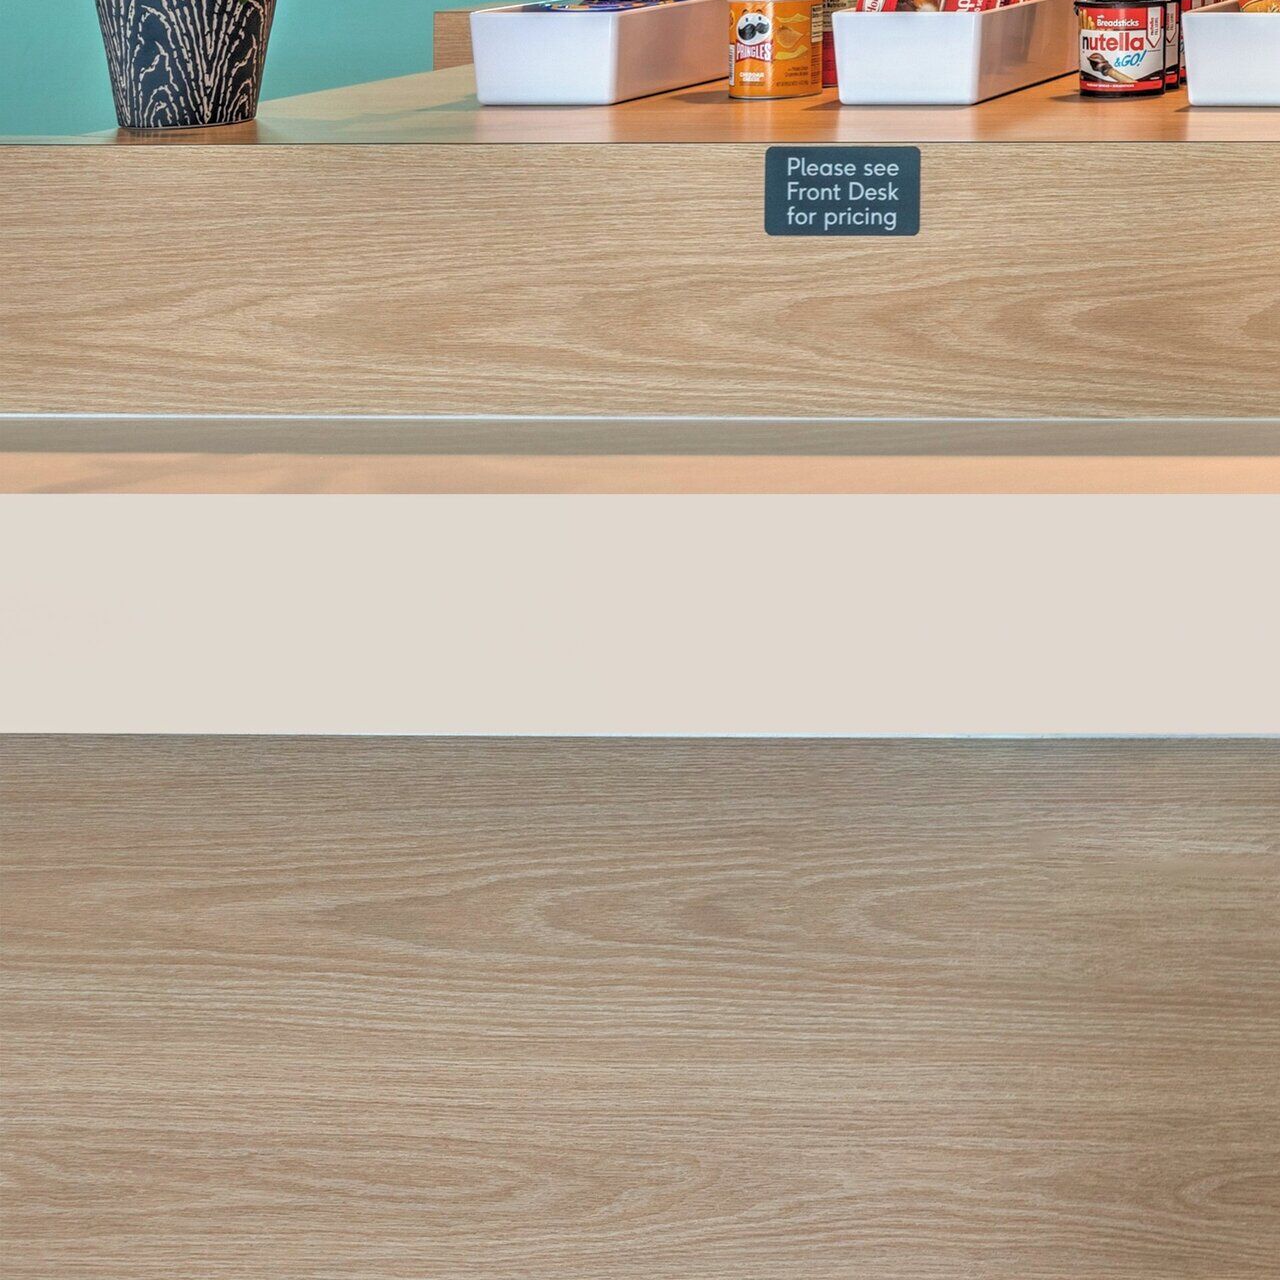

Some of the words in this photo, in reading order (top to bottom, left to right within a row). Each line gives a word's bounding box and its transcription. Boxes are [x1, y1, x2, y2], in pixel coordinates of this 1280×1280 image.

[1097, 19, 1139, 27] Breadsticks
[736, 43, 772, 61] PRINGLES
[1082, 32, 1145, 52] nutella
[787, 157, 857, 177] Please
[863, 163, 900, 177] see
[787, 181, 841, 201] Front
[848, 181, 900, 201] Desk
[787, 206, 817, 225] for
[824, 207, 897, 231] pricing
